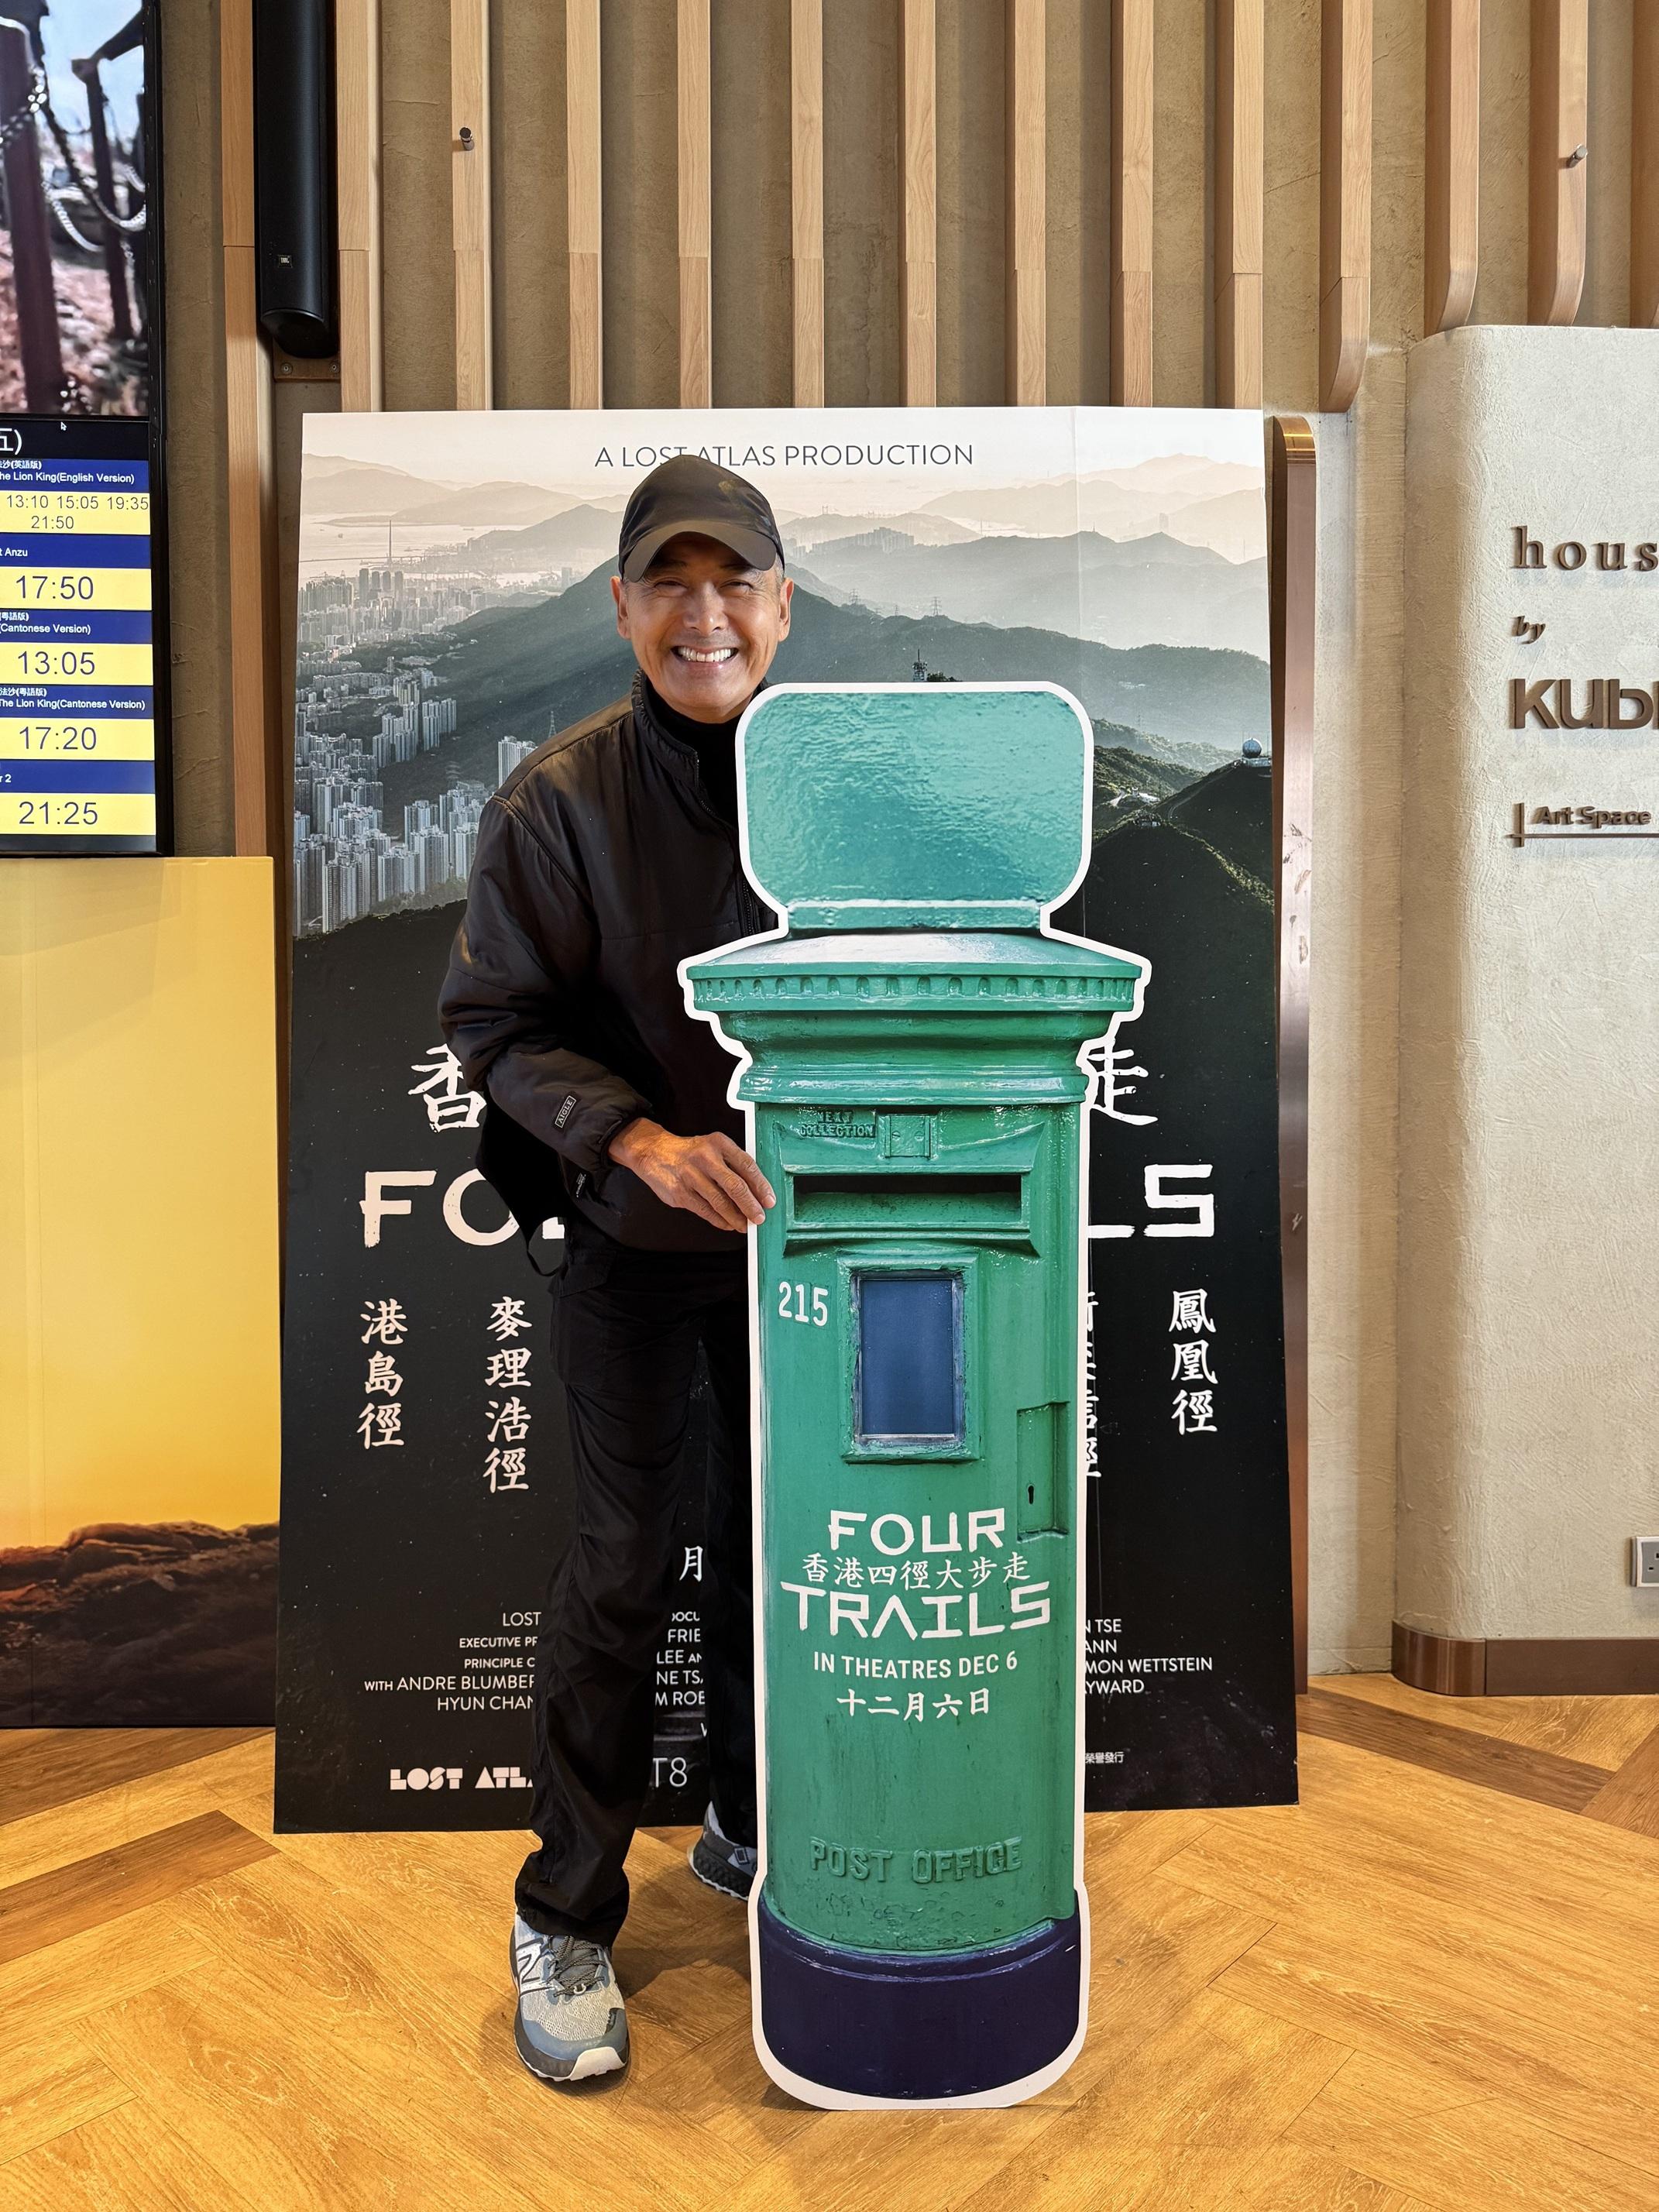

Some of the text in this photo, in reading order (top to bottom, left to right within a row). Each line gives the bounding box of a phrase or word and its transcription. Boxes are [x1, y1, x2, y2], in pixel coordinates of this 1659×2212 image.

[0, 460, 43, 469] 沙(英語版)
[595, 447, 613, 466] A
[699, 445, 776, 466] ATLAS
[785, 444, 973, 465] PRODUCTION
[13, 472, 33, 481] Lion
[36, 472, 94, 483] King(English
[96, 473, 135, 485] Version)
[6, 495, 149, 510] 13:10 15:05 19:35
[31, 515, 74, 530] 21:50
[5, 548, 28, 557] Anzu
[15, 575, 94, 600] 17:50
[53, 623, 91, 635] Version)
[1511, 616, 1546, 644] by
[18, 651, 95, 675] 13:05
[16, 699, 34, 708] Lion
[36, 699, 107, 710] King(Cantonese
[109, 700, 145, 710] Version)
[19, 726, 97, 750] 17:20
[5, 773, 12, 783] 2
[19, 801, 98, 826] 21:25
[1530, 805, 1652, 829] Art Space
[407, 1043, 487, 1133] 香
[799, 1123, 876, 1138] COLLECTION
[359, 1168, 565, 1249] FO
[778, 1281, 829, 1328] 215
[356, 1297, 408, 1450] 港島徑
[1168, 1288, 1218, 1436] 鳳凰徑
[483, 1296, 533, 1493] 麥理浩徑
[828, 1507, 1005, 1556] FOUR
[678, 1545, 704, 1582] 月
[802, 1551, 1031, 1591] 香港四徑大步走
[502, 1612, 542, 1626] LOST
[780, 1581, 1051, 1641] TRAILS
[459, 1636, 522, 1648] EXECUTIVE
[1094, 1618, 1122, 1633] TSE
[364, 1680, 393, 1692] WITH
[396, 1675, 457, 1692] ANDRE
[1127, 1657, 1213, 1673] WETTSTEIN
[464, 1657, 524, 1669] PRINCIPLE
[813, 1650, 1018, 1679] IN THEATRES DEC 6
[437, 1696, 486, 1712] HYUN
[1086, 1678, 1146, 1695] YWARD
[836, 1687, 991, 1723] 十二月六日
[390, 1766, 463, 1791] LOST
[810, 1836, 1023, 1884] POST OFFICE
